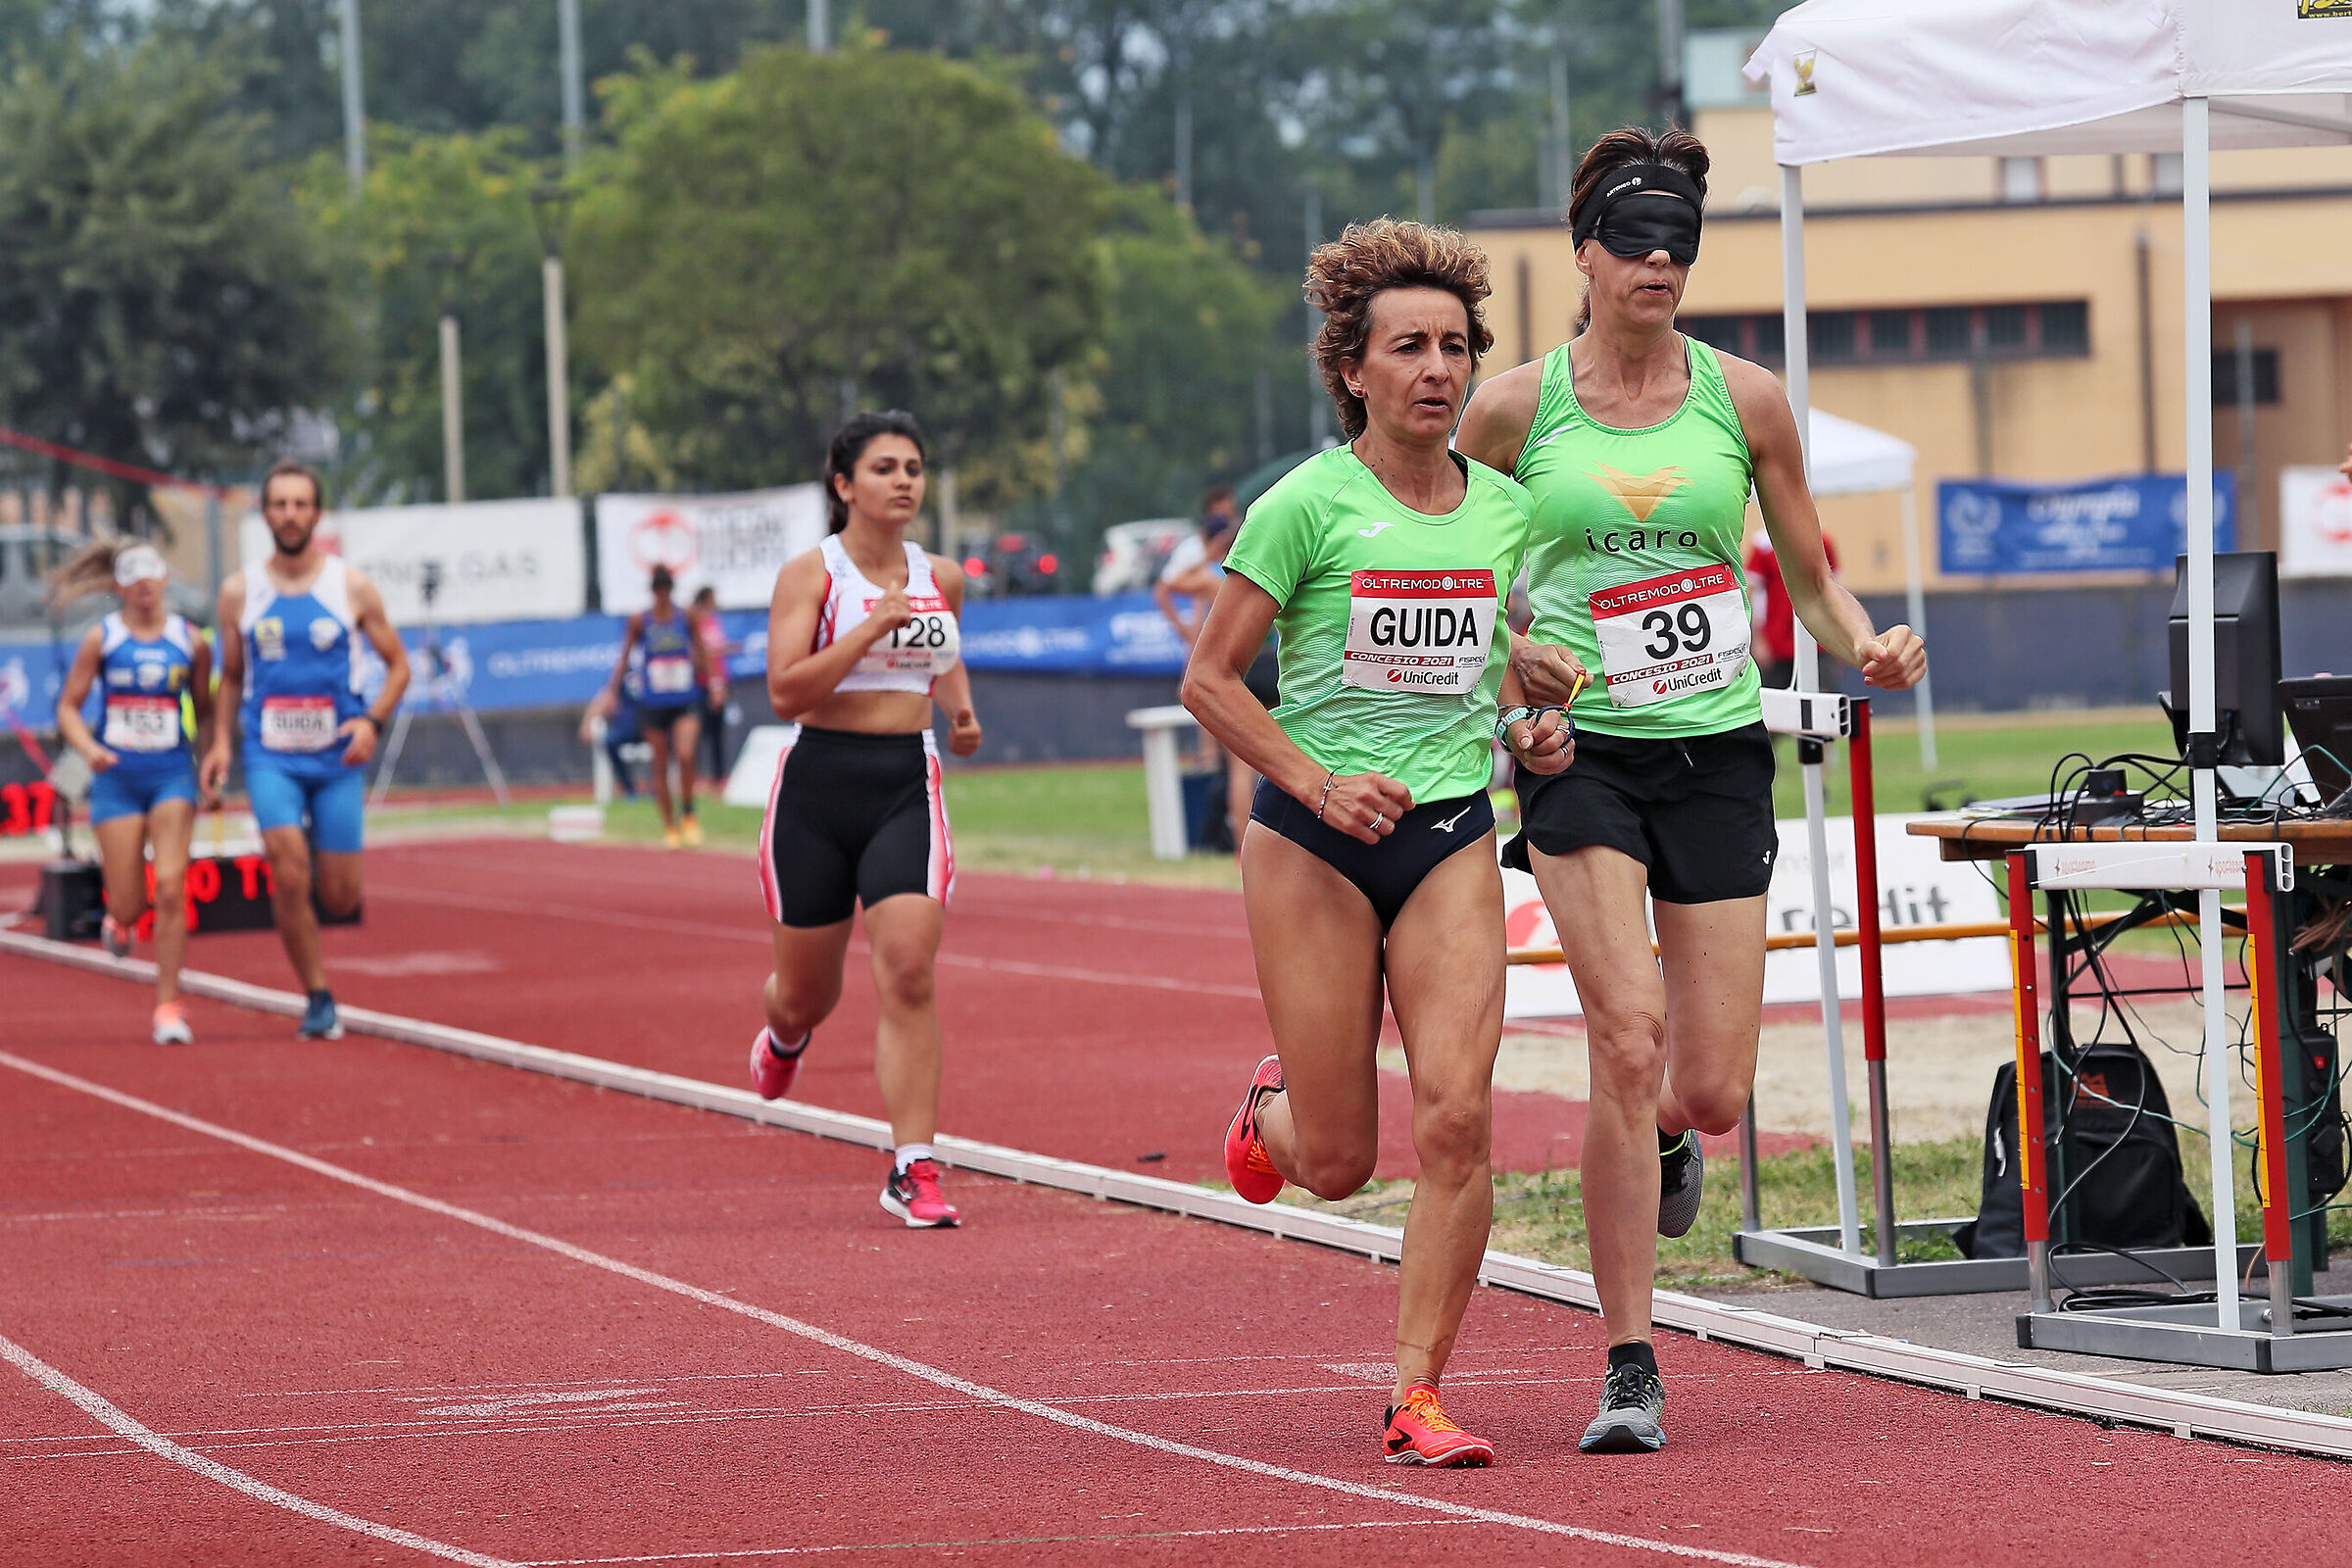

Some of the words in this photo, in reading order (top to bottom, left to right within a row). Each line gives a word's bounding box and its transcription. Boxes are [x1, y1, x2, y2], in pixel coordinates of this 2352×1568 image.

[1585, 528, 1698, 553] icaro
[892, 616, 946, 649] 128
[1370, 607, 1479, 647] GUIDA
[1642, 603, 1711, 661] 39
[1350, 652, 1420, 665] CONCESIO
[1420, 657, 1453, 666] 2021
[1611, 662, 1679, 684] CONCESIO
[1679, 655, 1712, 668] 2021
[1402, 670, 1459, 686] UniCredit
[1668, 667, 1723, 692] UniCredit
